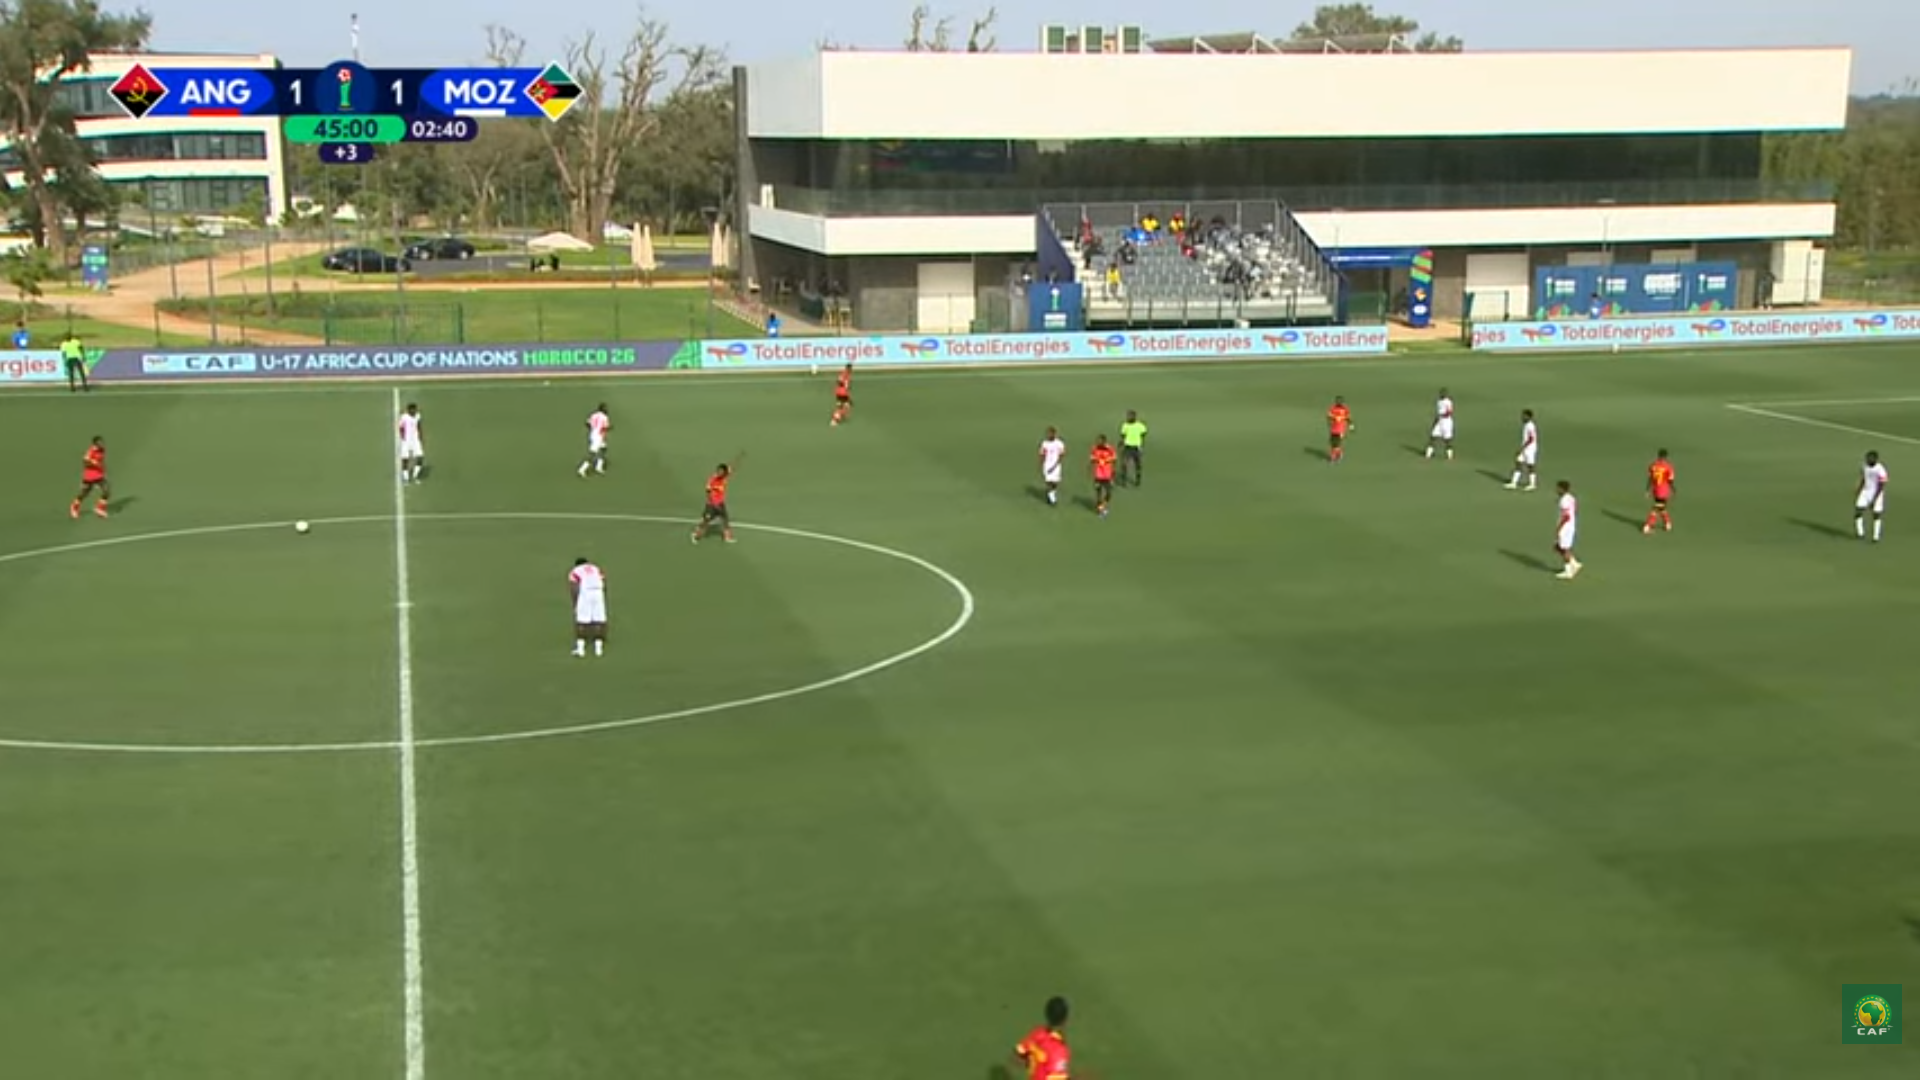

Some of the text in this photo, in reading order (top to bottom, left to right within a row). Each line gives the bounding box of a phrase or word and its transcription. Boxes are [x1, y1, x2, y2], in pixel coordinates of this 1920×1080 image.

[1560, 321, 1675, 345] TotalEnergies
[1731, 316, 1843, 338] TotalEnergies
[945, 338, 1070, 359] TotalEnergies
[1130, 333, 1252, 354] TotalEnergies
[1304, 330, 1385, 347] TotalEner
[262, 354, 300, 370] U-17
[305, 353, 371, 369] AFRICA
[373, 352, 408, 368] CUP
[412, 352, 437, 367] OF
[440, 351, 518, 367] NATIONS
[523, 349, 607, 366] MOROCCO
[753, 341, 884, 362] TotalEnergies
[185, 356, 243, 370] CAF
